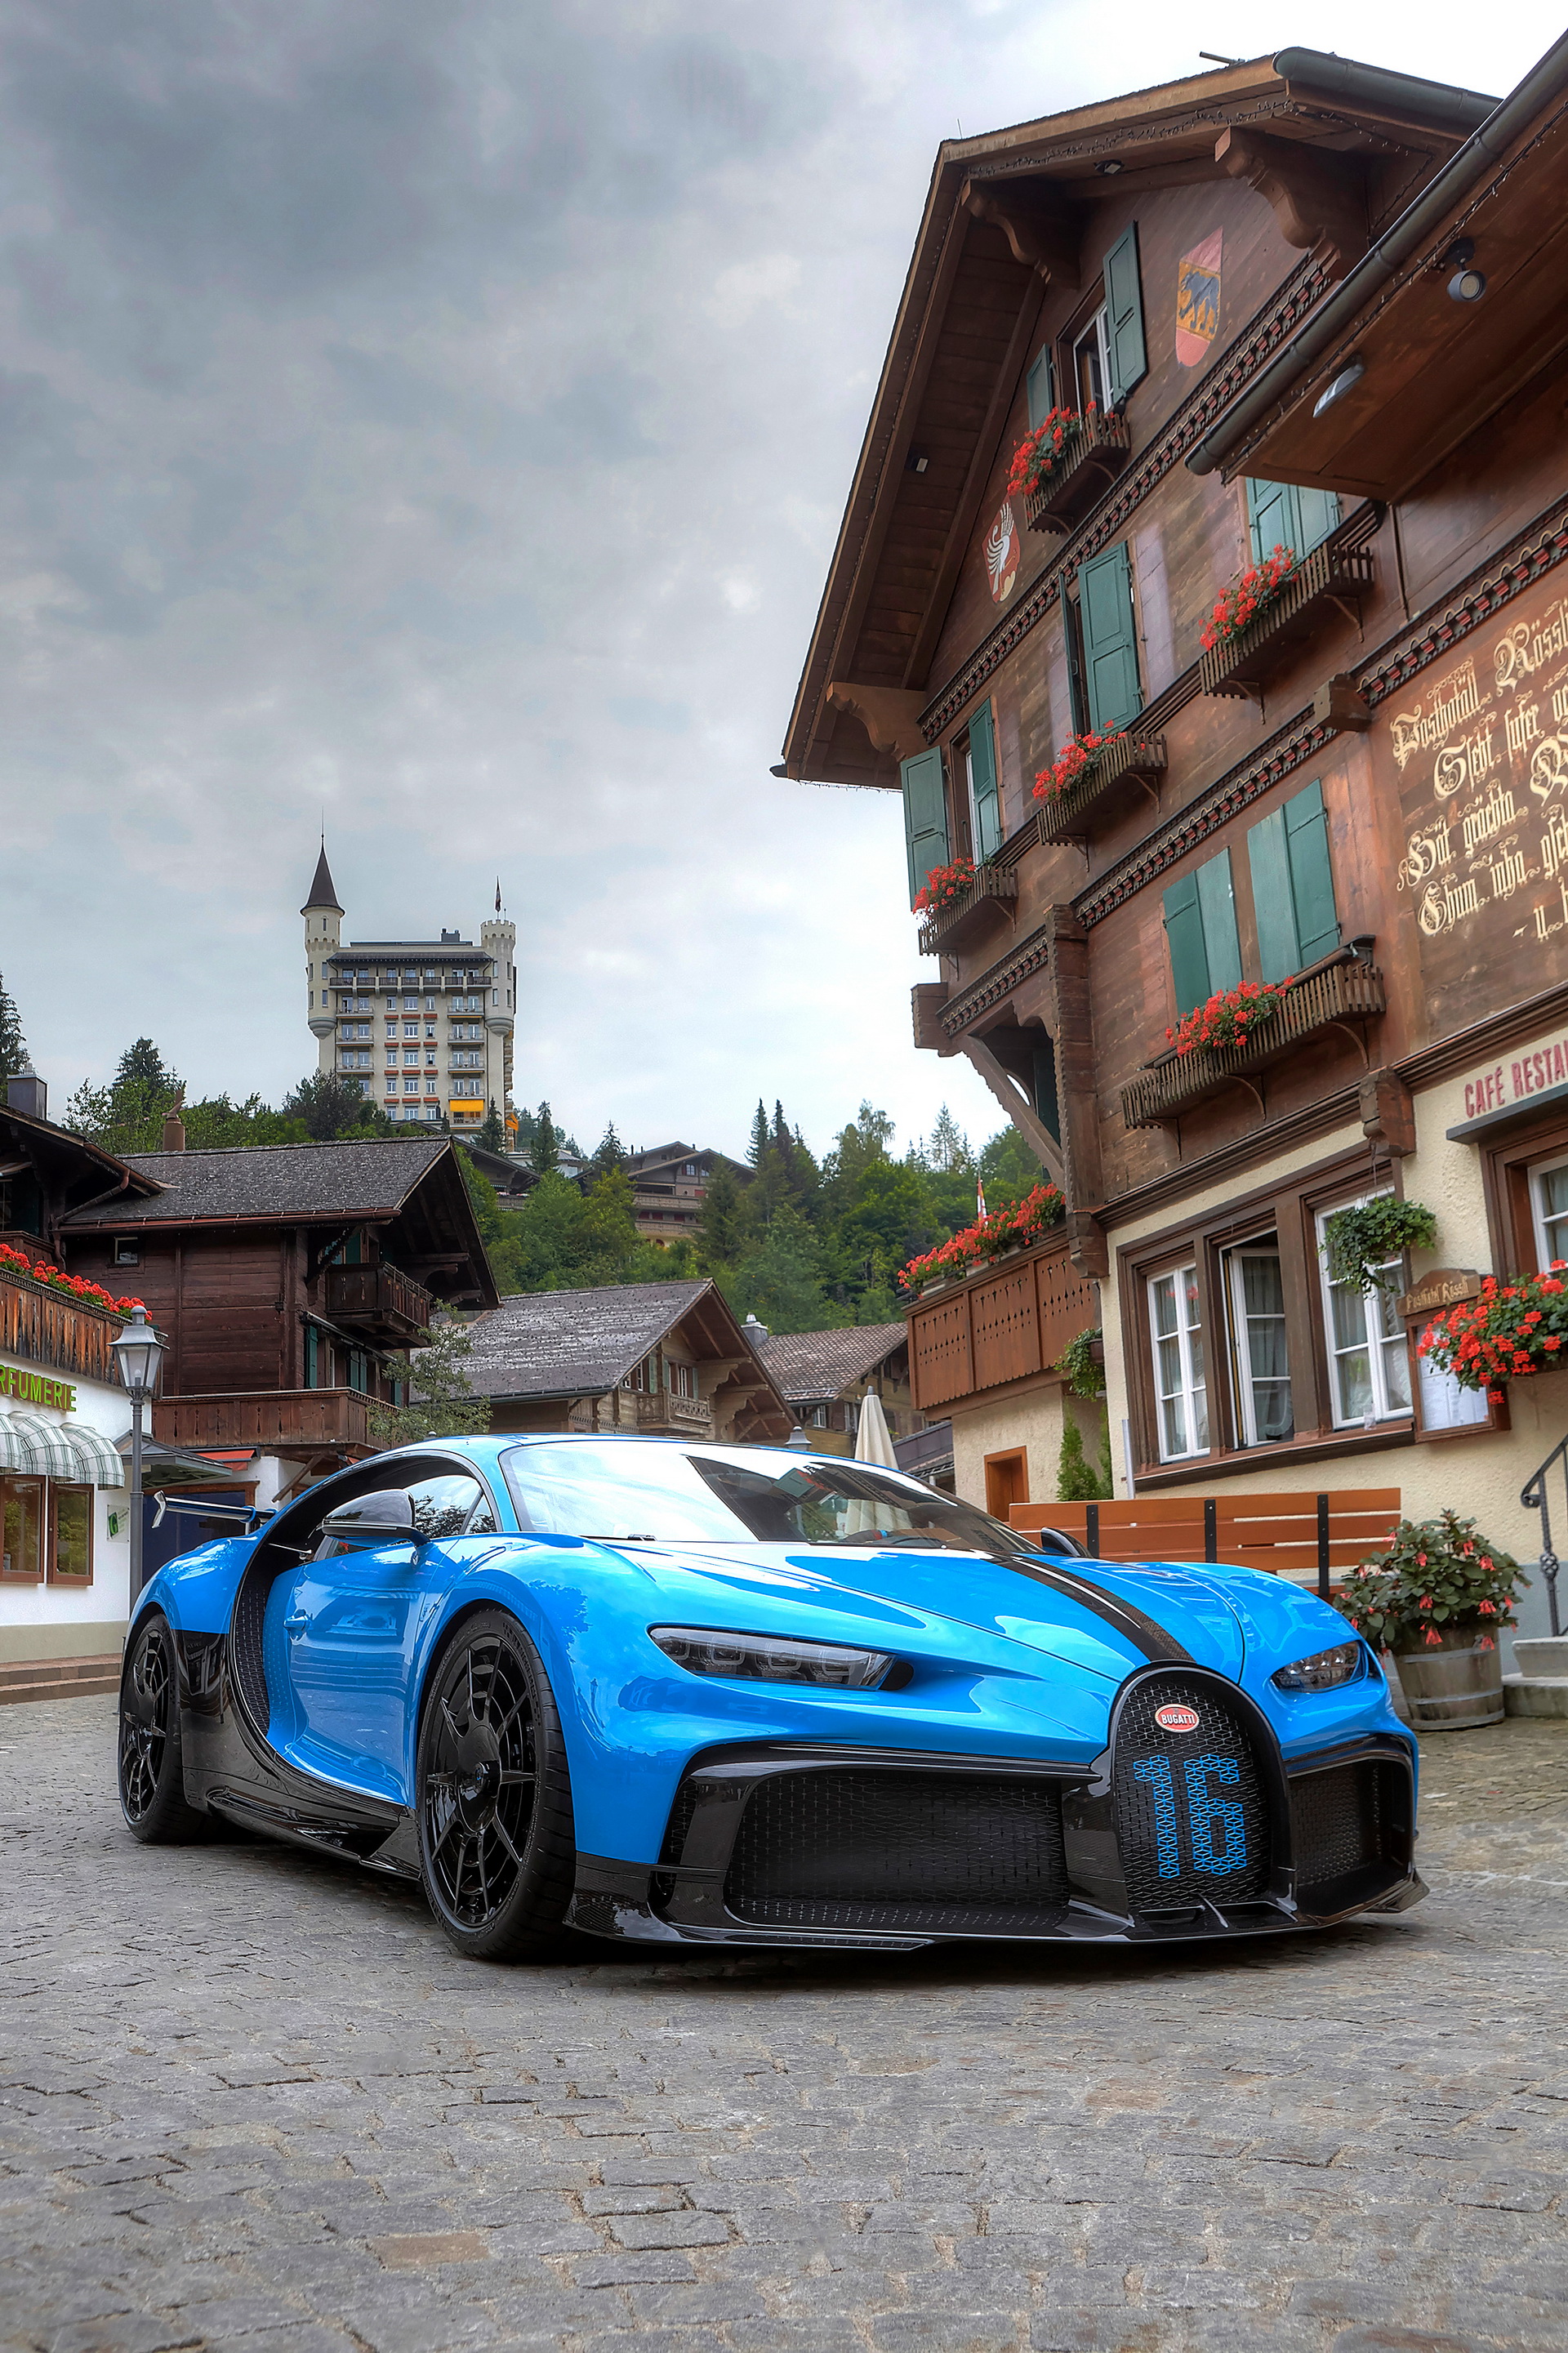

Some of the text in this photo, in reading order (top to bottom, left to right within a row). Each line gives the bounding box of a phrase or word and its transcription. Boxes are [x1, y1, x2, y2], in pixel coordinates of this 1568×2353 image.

[1464, 1066, 1505, 1118] CAFÉ
[1160, 1714, 1196, 1725] BUGATTI
[1134, 1754, 1247, 1878] 16
